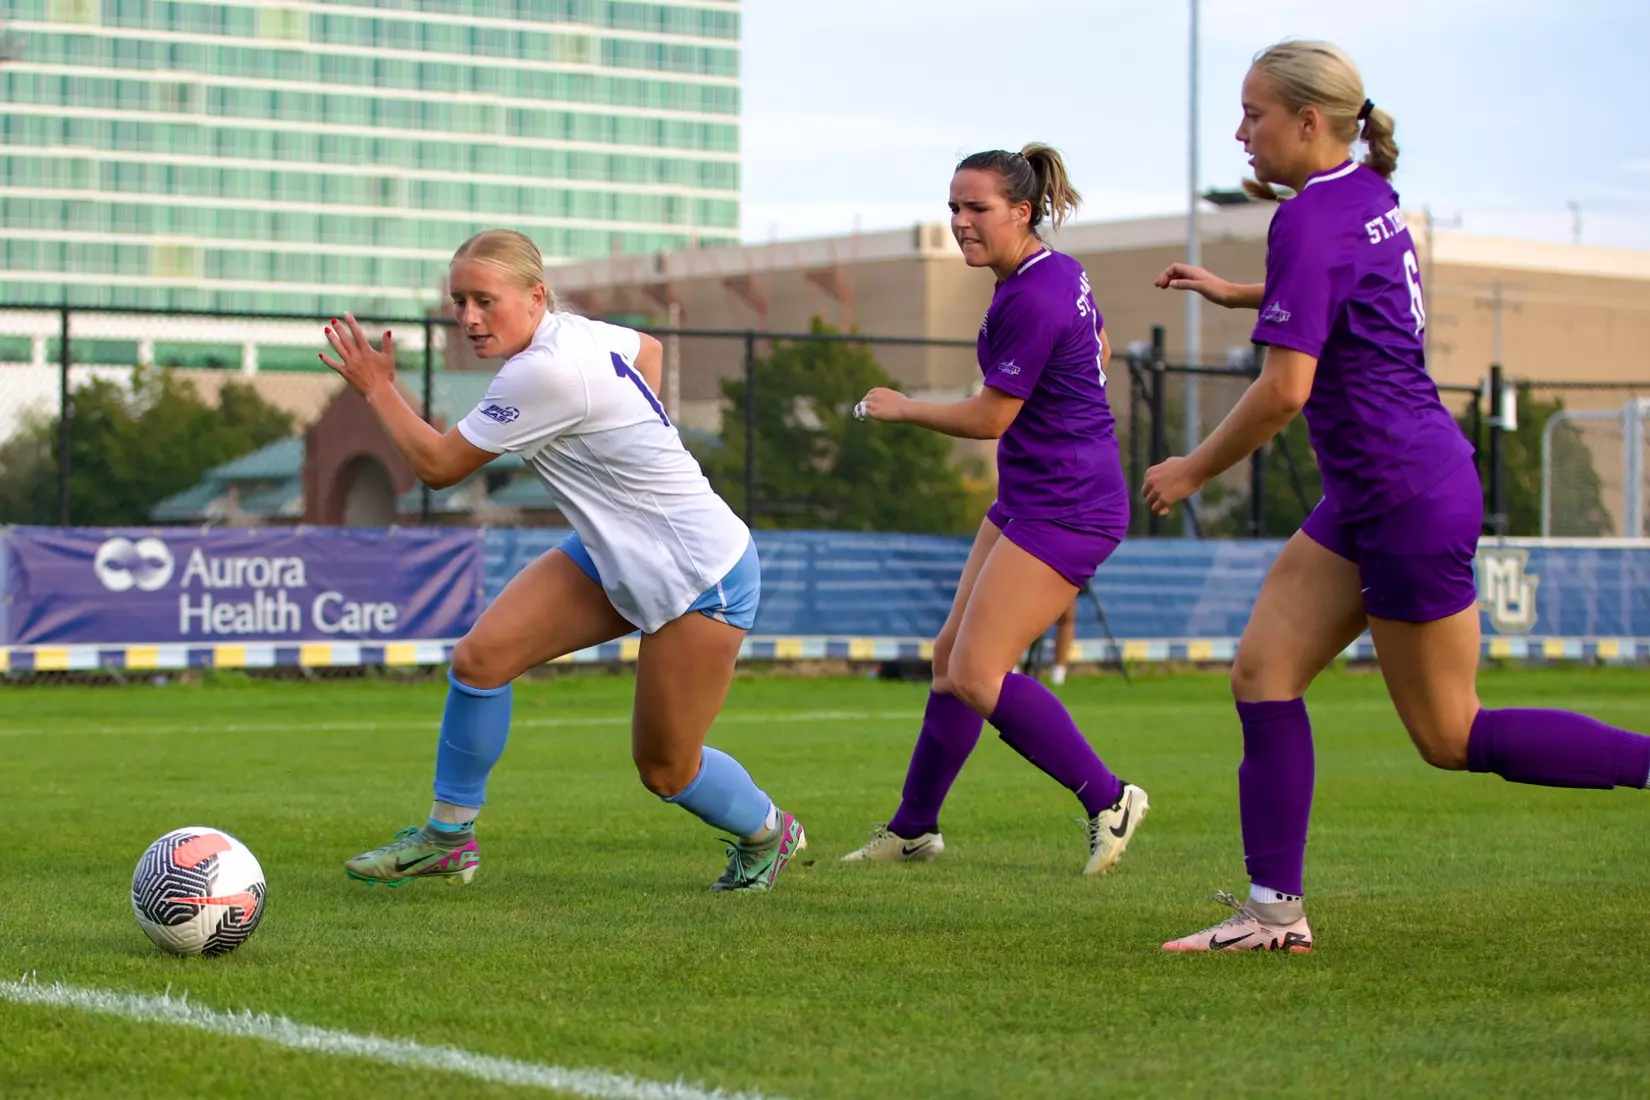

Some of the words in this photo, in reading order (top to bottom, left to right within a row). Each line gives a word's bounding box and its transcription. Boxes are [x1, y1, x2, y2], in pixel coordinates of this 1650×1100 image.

[483, 409, 515, 424] EAST
[486, 404, 514, 416] BIG
[180, 548, 306, 589] Aurora
[1482, 552, 1533, 627] MU
[179, 590, 301, 634] Health
[312, 592, 397, 634] Care
